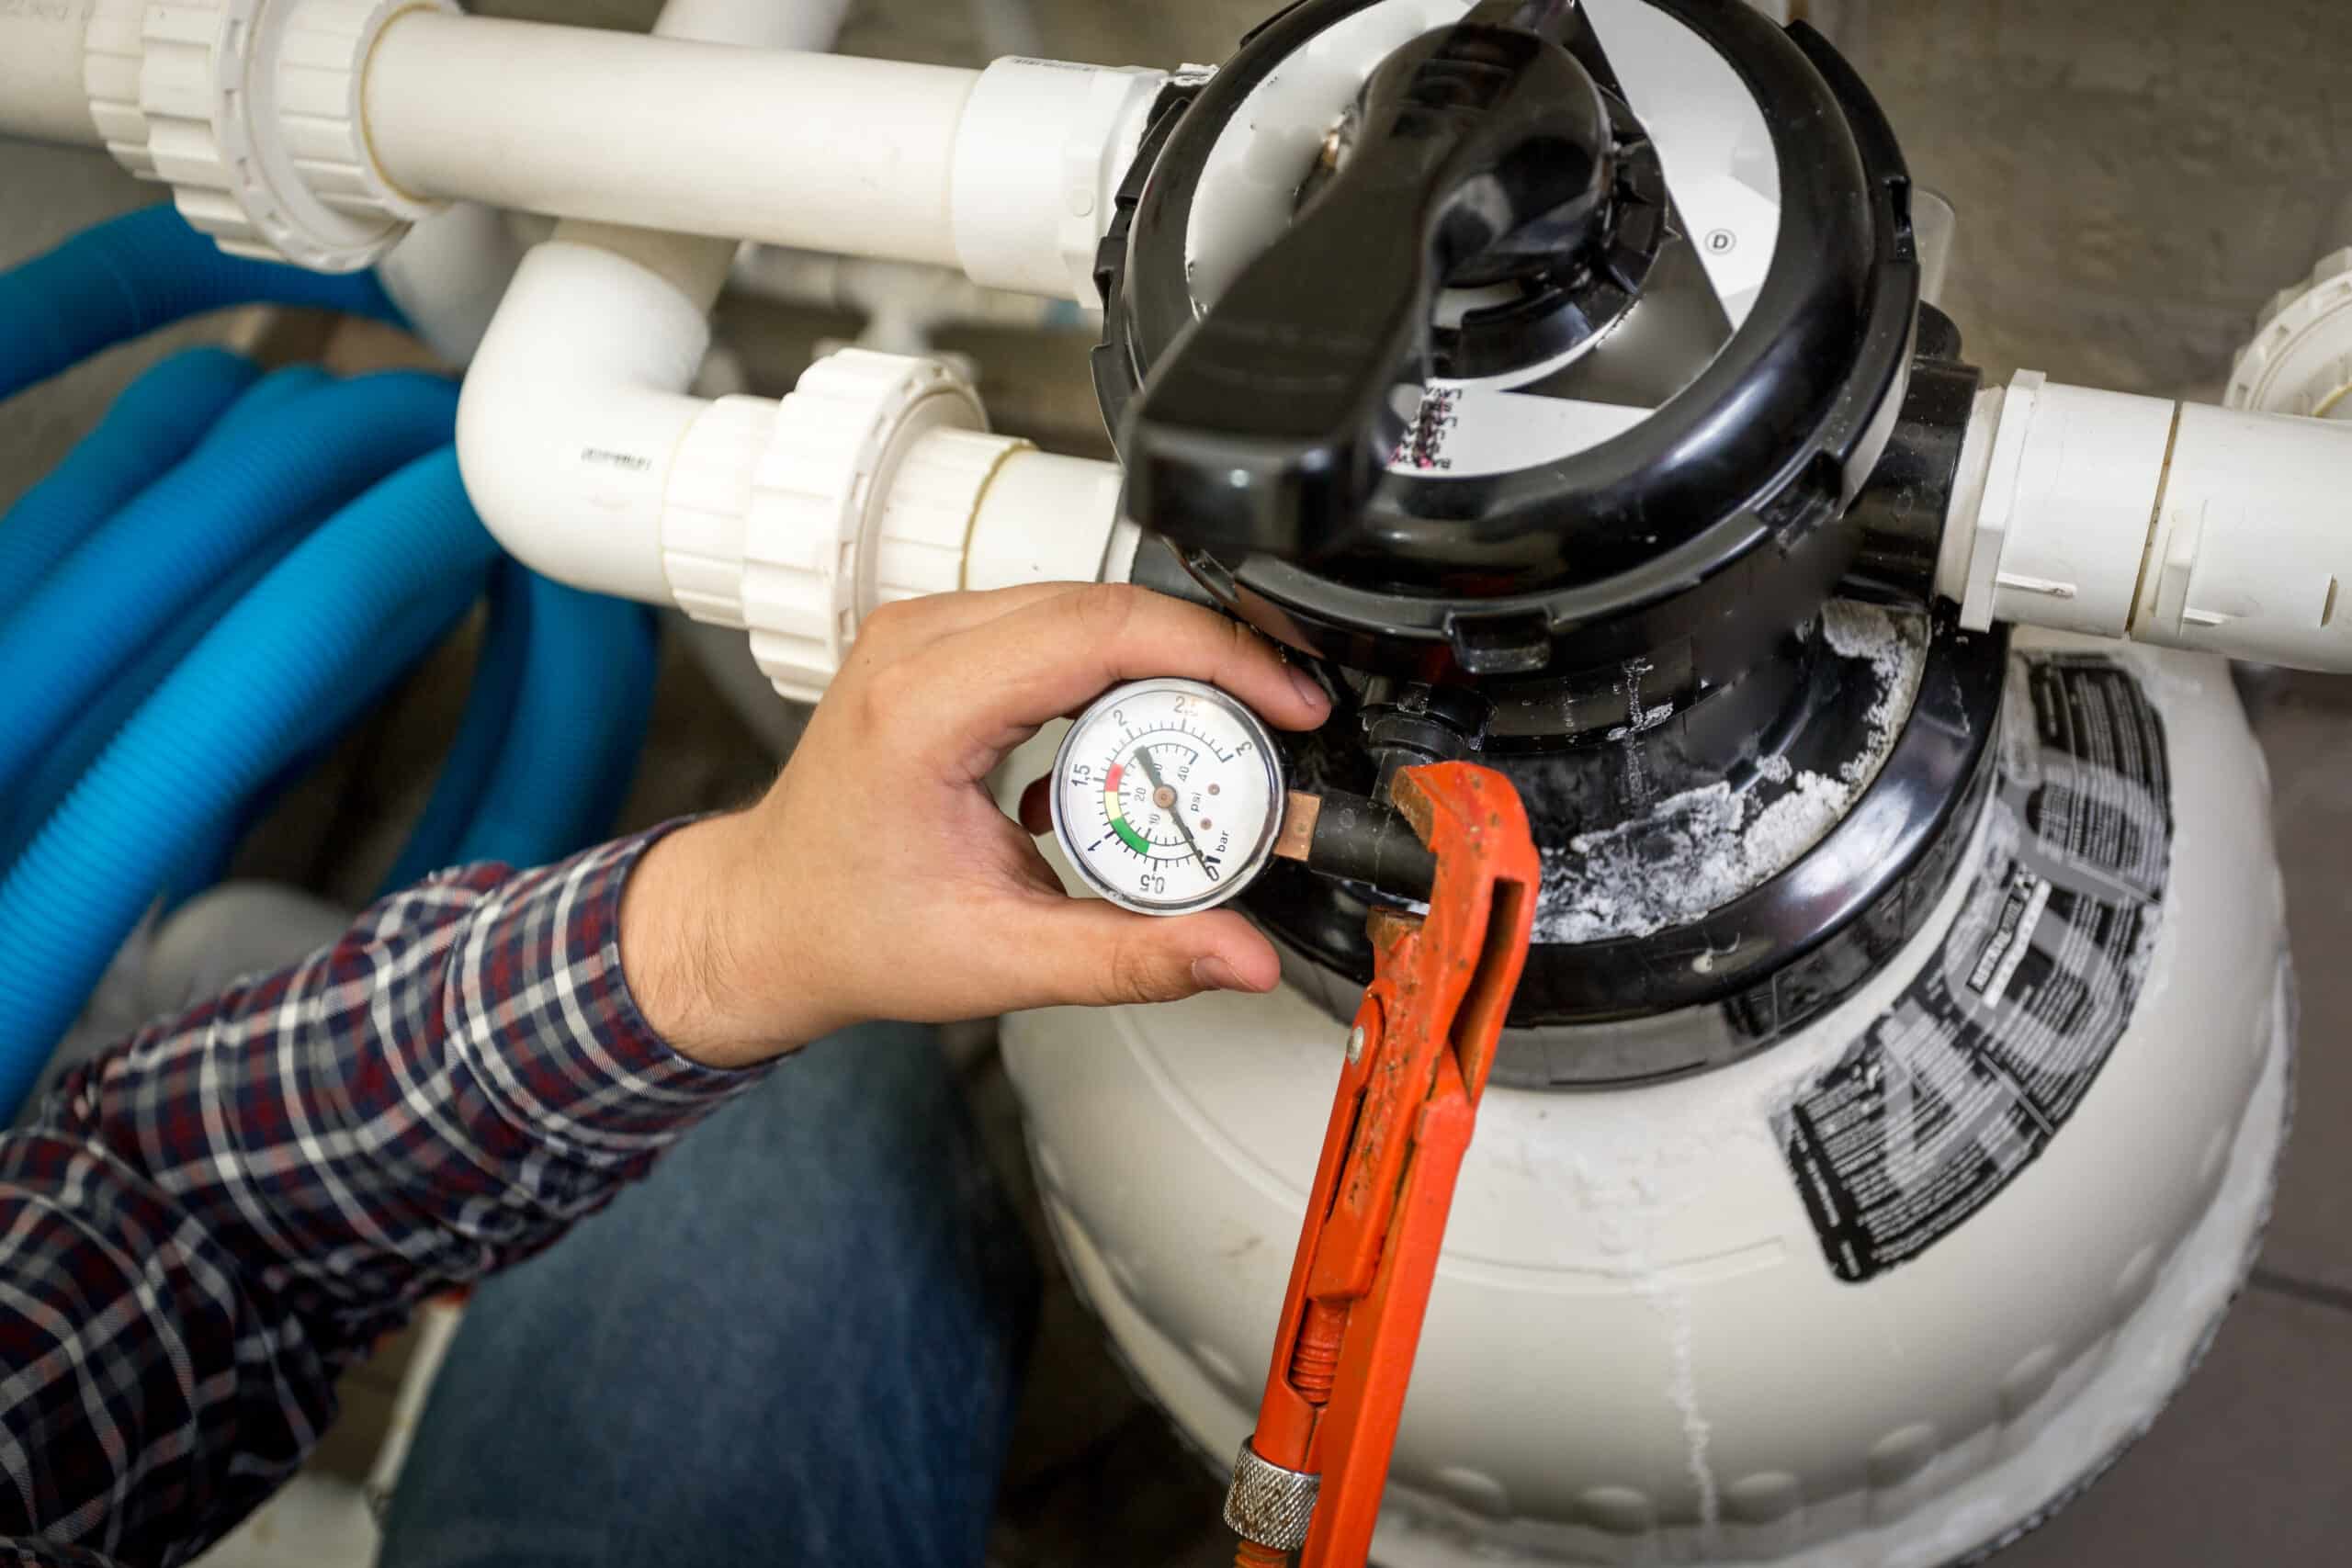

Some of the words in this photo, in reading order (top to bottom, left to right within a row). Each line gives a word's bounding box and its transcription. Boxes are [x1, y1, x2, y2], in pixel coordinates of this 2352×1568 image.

[1713, 234, 1728, 249] D
[1113, 709, 1127, 727] 2
[1235, 740, 1253, 757] 3
[1070, 763, 1091, 787] 1,5
[1177, 765, 1191, 783] 40
[1134, 786, 1147, 802] 20
[1190, 792, 1203, 813] psi
[1147, 813, 1161, 825] 10
[1087, 840, 1102, 852] 1
[1215, 829, 1229, 853] bar
[1139, 874, 1166, 895] 0,5
